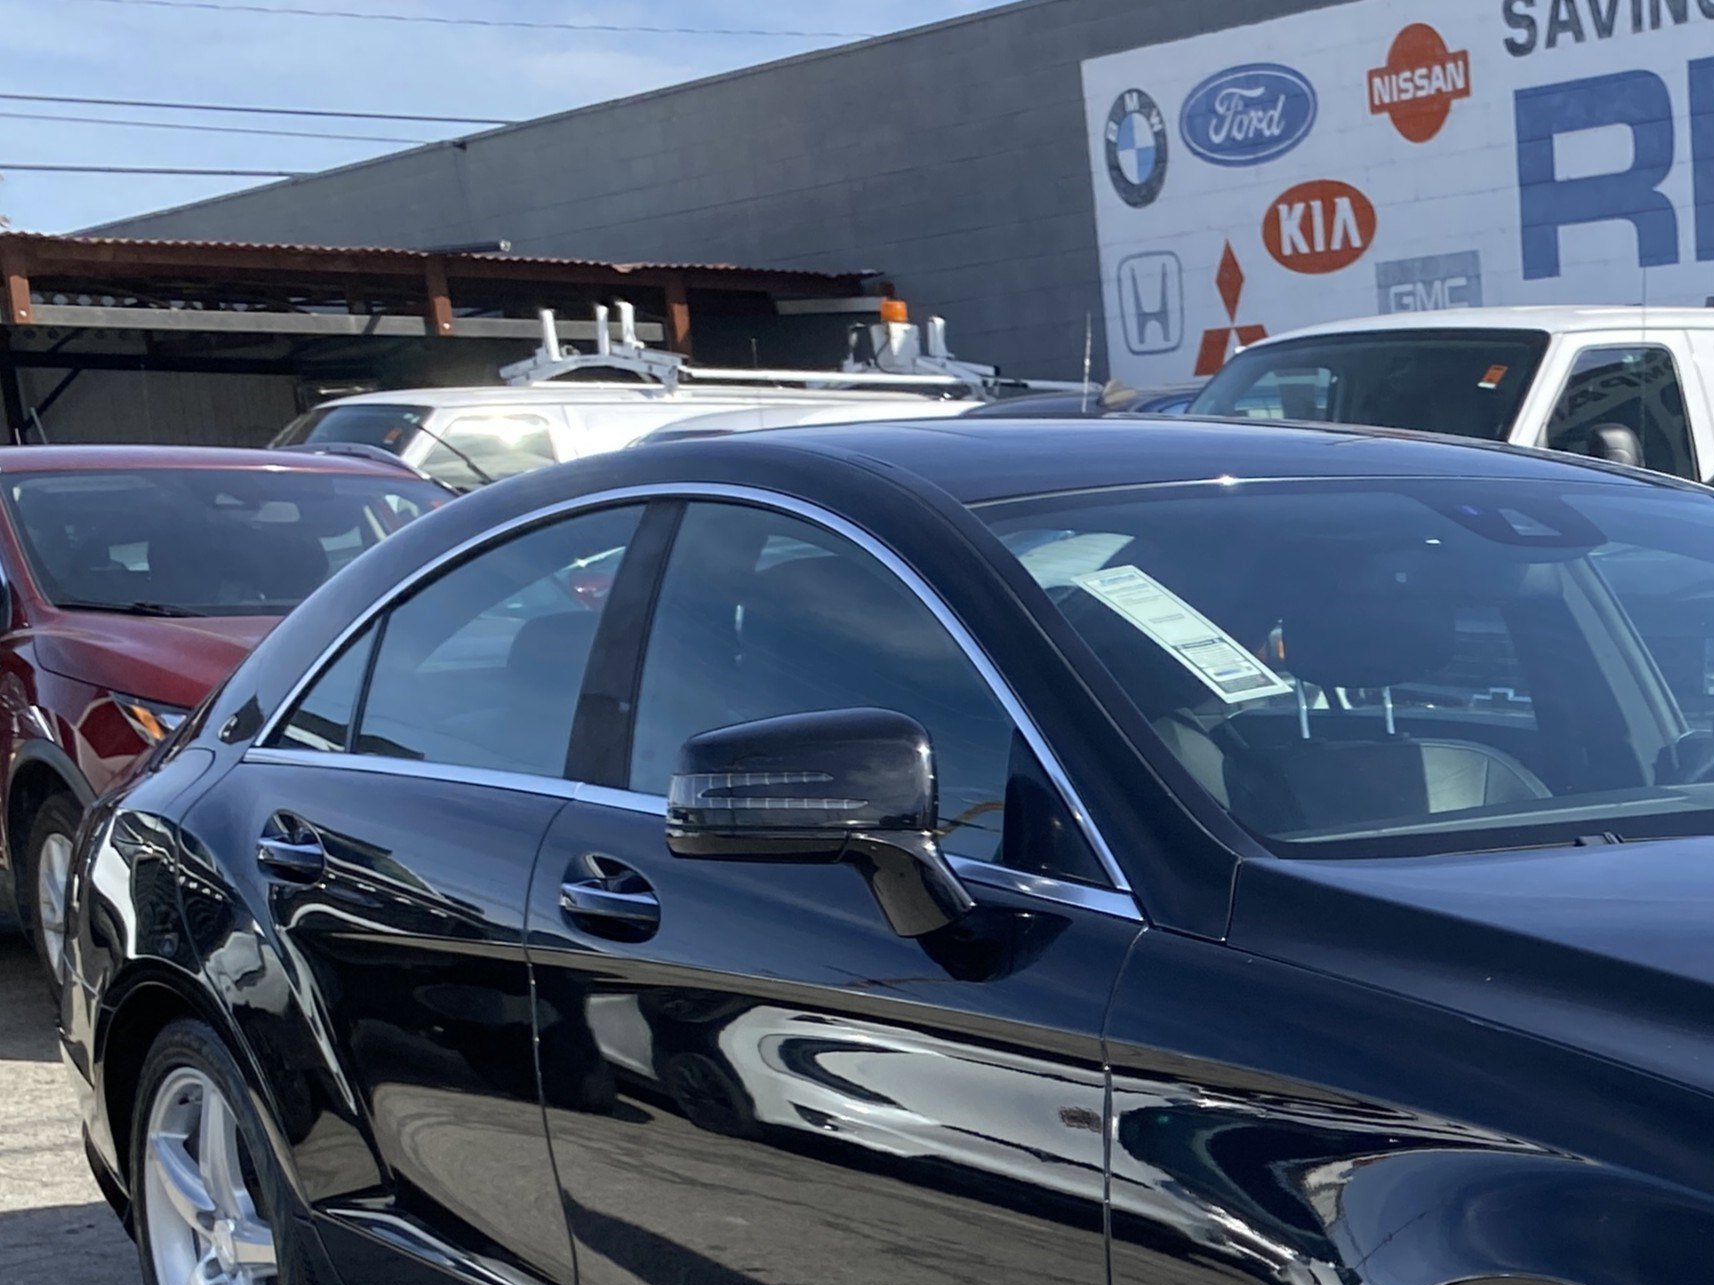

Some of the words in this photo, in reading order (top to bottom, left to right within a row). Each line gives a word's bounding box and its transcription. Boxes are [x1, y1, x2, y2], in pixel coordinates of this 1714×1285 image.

[1371, 59, 1467, 107] NISSAN
[1208, 86, 1287, 144] Ford
[1278, 198, 1363, 256] KIA
[1390, 277, 1471, 312] GMC
